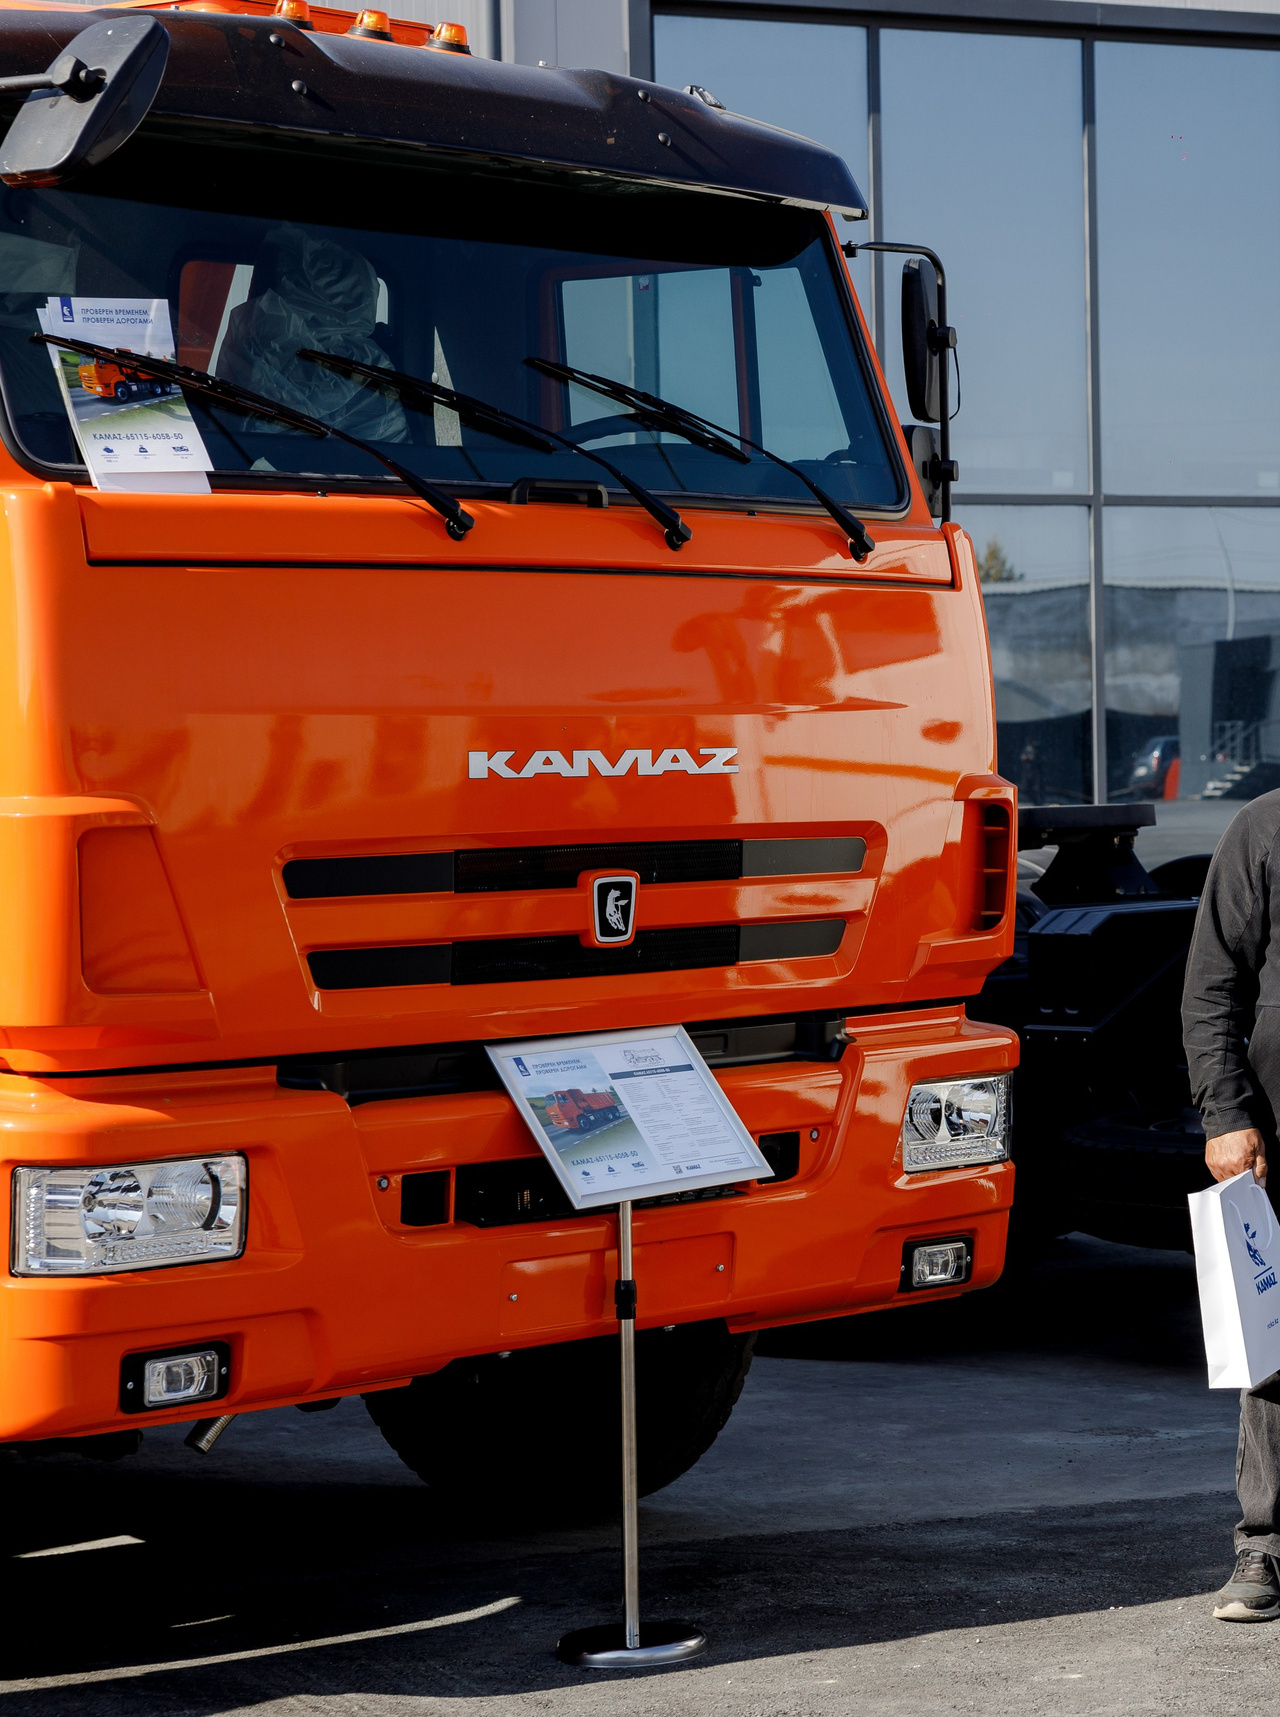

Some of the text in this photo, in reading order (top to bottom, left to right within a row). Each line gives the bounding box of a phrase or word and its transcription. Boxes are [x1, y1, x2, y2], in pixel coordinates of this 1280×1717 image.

[92, 432, 184, 441] KAMAZ-65115-6058-50
[467, 746, 740, 779] KAMAZ
[1255, 1271, 1278, 1295] KAMAZ
